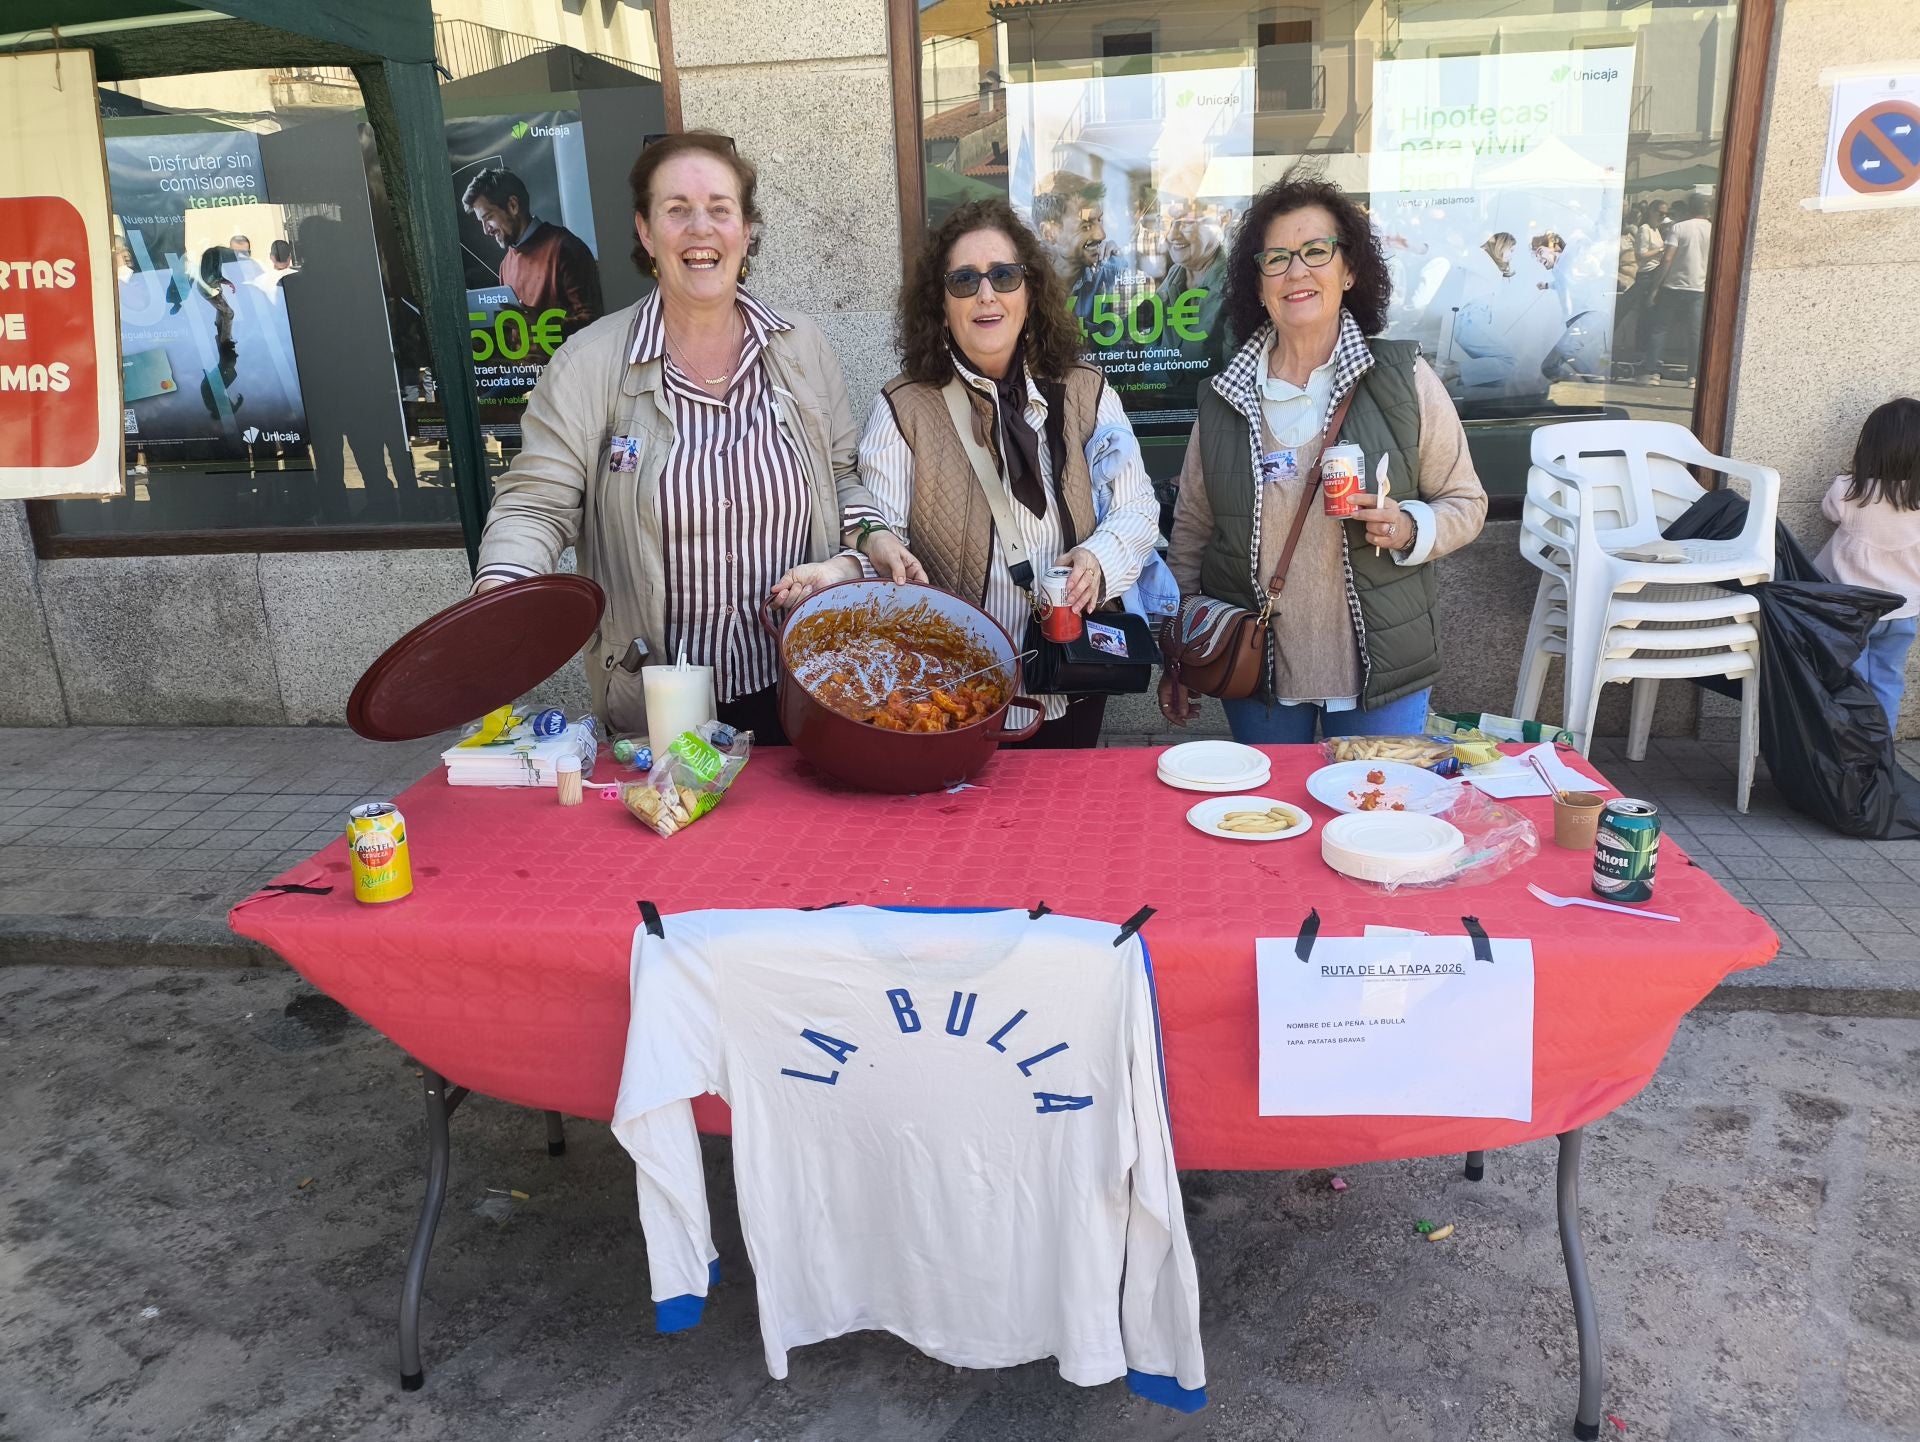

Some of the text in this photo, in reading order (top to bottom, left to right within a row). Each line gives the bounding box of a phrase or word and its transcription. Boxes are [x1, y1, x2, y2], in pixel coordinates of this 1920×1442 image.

[1573, 68, 1618, 82] Unicaja
[1197, 93, 1239, 106] Unicaja
[1401, 103, 1549, 138] Hipotecas
[530, 125, 570, 138] Unicaja
[1401, 130, 1531, 164] para vivir
[149, 152, 252, 172] Disfrutar sin
[160, 174, 255, 192] comisiones
[189, 192, 258, 209] te renta
[1431, 196, 1475, 206] hablamos
[123, 215, 153, 225] Nueva
[1114, 275, 1147, 285] Hasta
[478, 294, 509, 304] Hasta
[0, 313, 27, 341] E
[1099, 351, 1124, 361] traer
[1126, 350, 1138, 359] tu
[1140, 348, 1182, 359] nómina,
[474, 365, 497, 375] traer
[500, 364, 511, 374] tu
[1105, 363, 1135, 373] cuota
[1137, 362, 1152, 372] de
[481, 378, 510, 387] cuota
[512, 376, 525, 386] de
[1120, 384, 1126, 392] y
[1127, 382, 1167, 391] hablamos
[358, 842, 391, 852] AMSTEL
[1595, 846, 1629, 867] ahou
[1321, 965, 1354, 975] RUTA
[1358, 965, 1375, 975] DE
[1379, 965, 1395, 975] LA
[1399, 964, 1431, 974] TAPA
[1308, 1037, 1337, 1045] PATATAS
[1338, 1036, 1366, 1044] BRAVAS
[780, 988, 1094, 1114] LA BULLA
